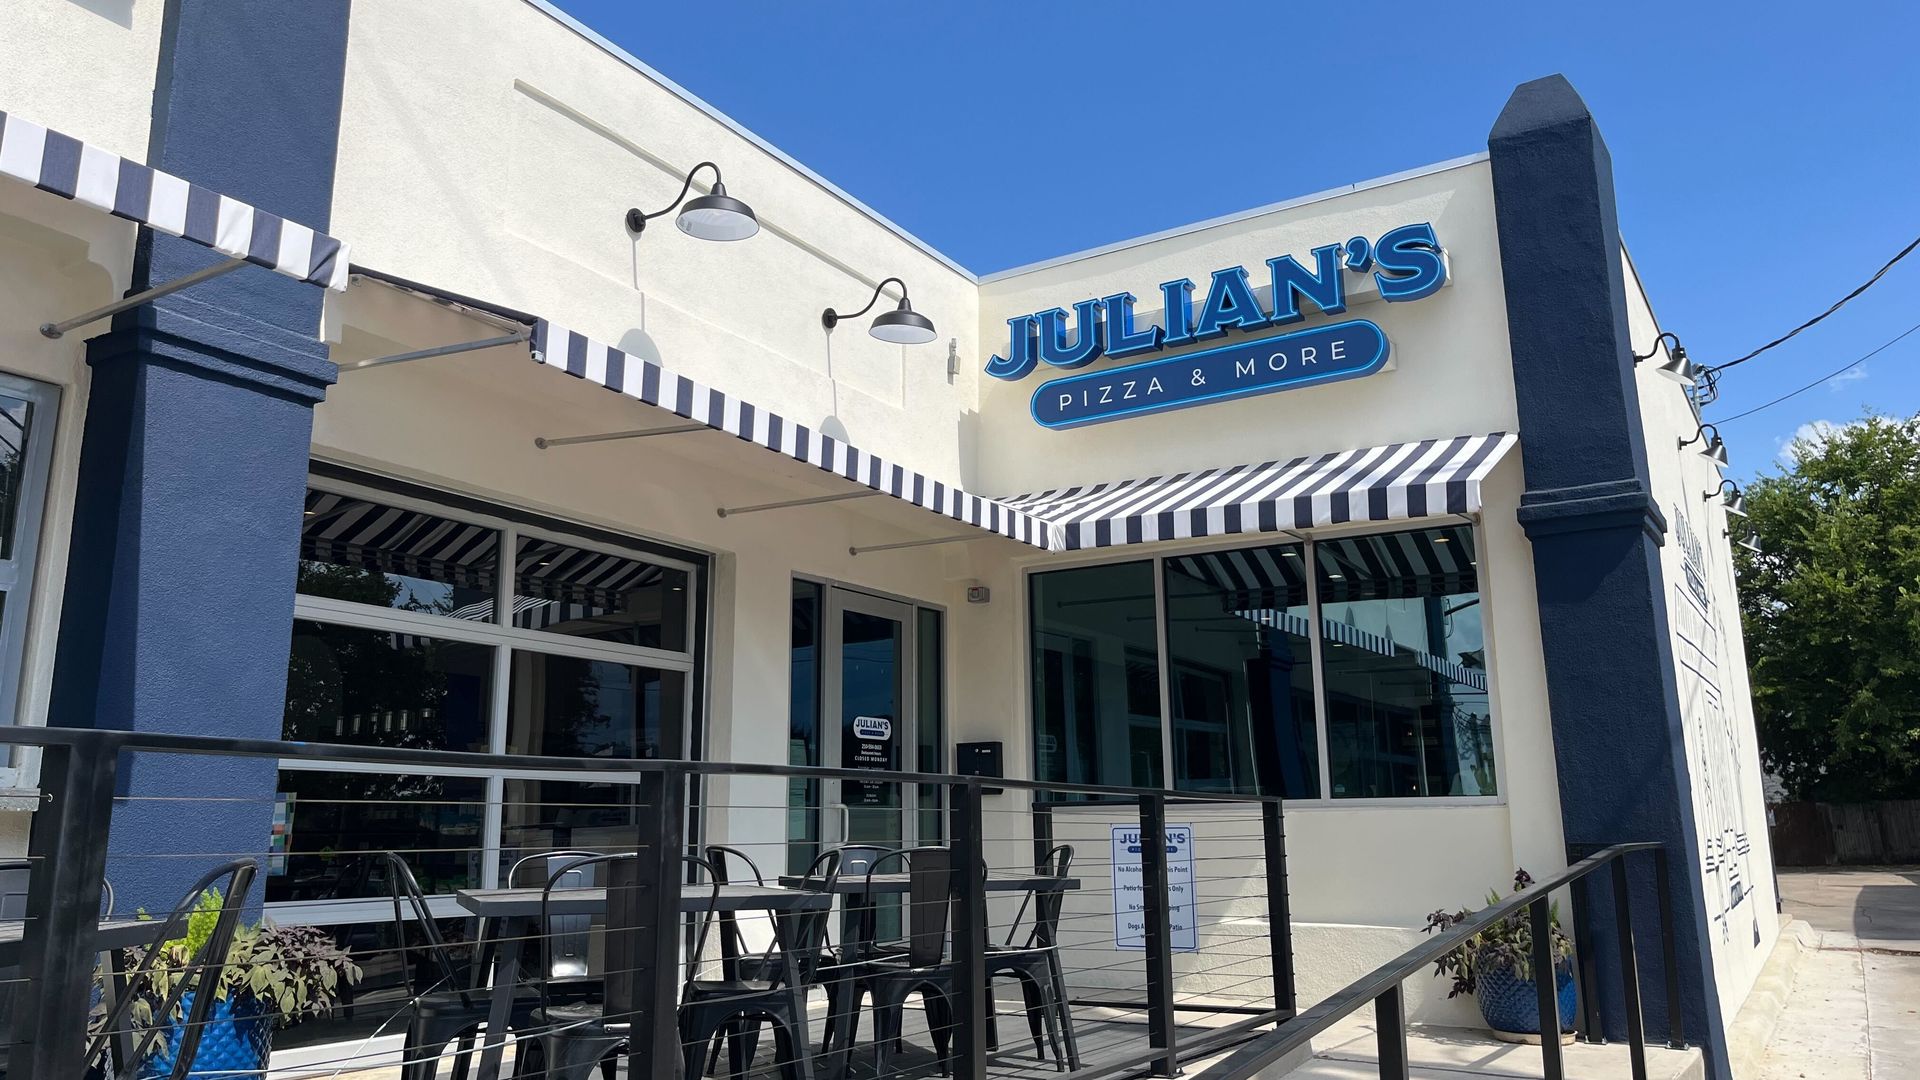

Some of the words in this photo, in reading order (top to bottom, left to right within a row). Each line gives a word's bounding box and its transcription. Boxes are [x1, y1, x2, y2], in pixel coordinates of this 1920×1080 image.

[985, 221, 1446, 380] JULIAN'S
[1058, 375, 1165, 411] PIZZA
[1190, 368, 1207, 386] &
[1235, 339, 1348, 378] MORE
[855, 719, 888, 730] JULIAN'S
[1120, 833, 1186, 844] JUN'S
[1172, 885, 1184, 893] Only
[1128, 922, 1140, 930] Dogs
